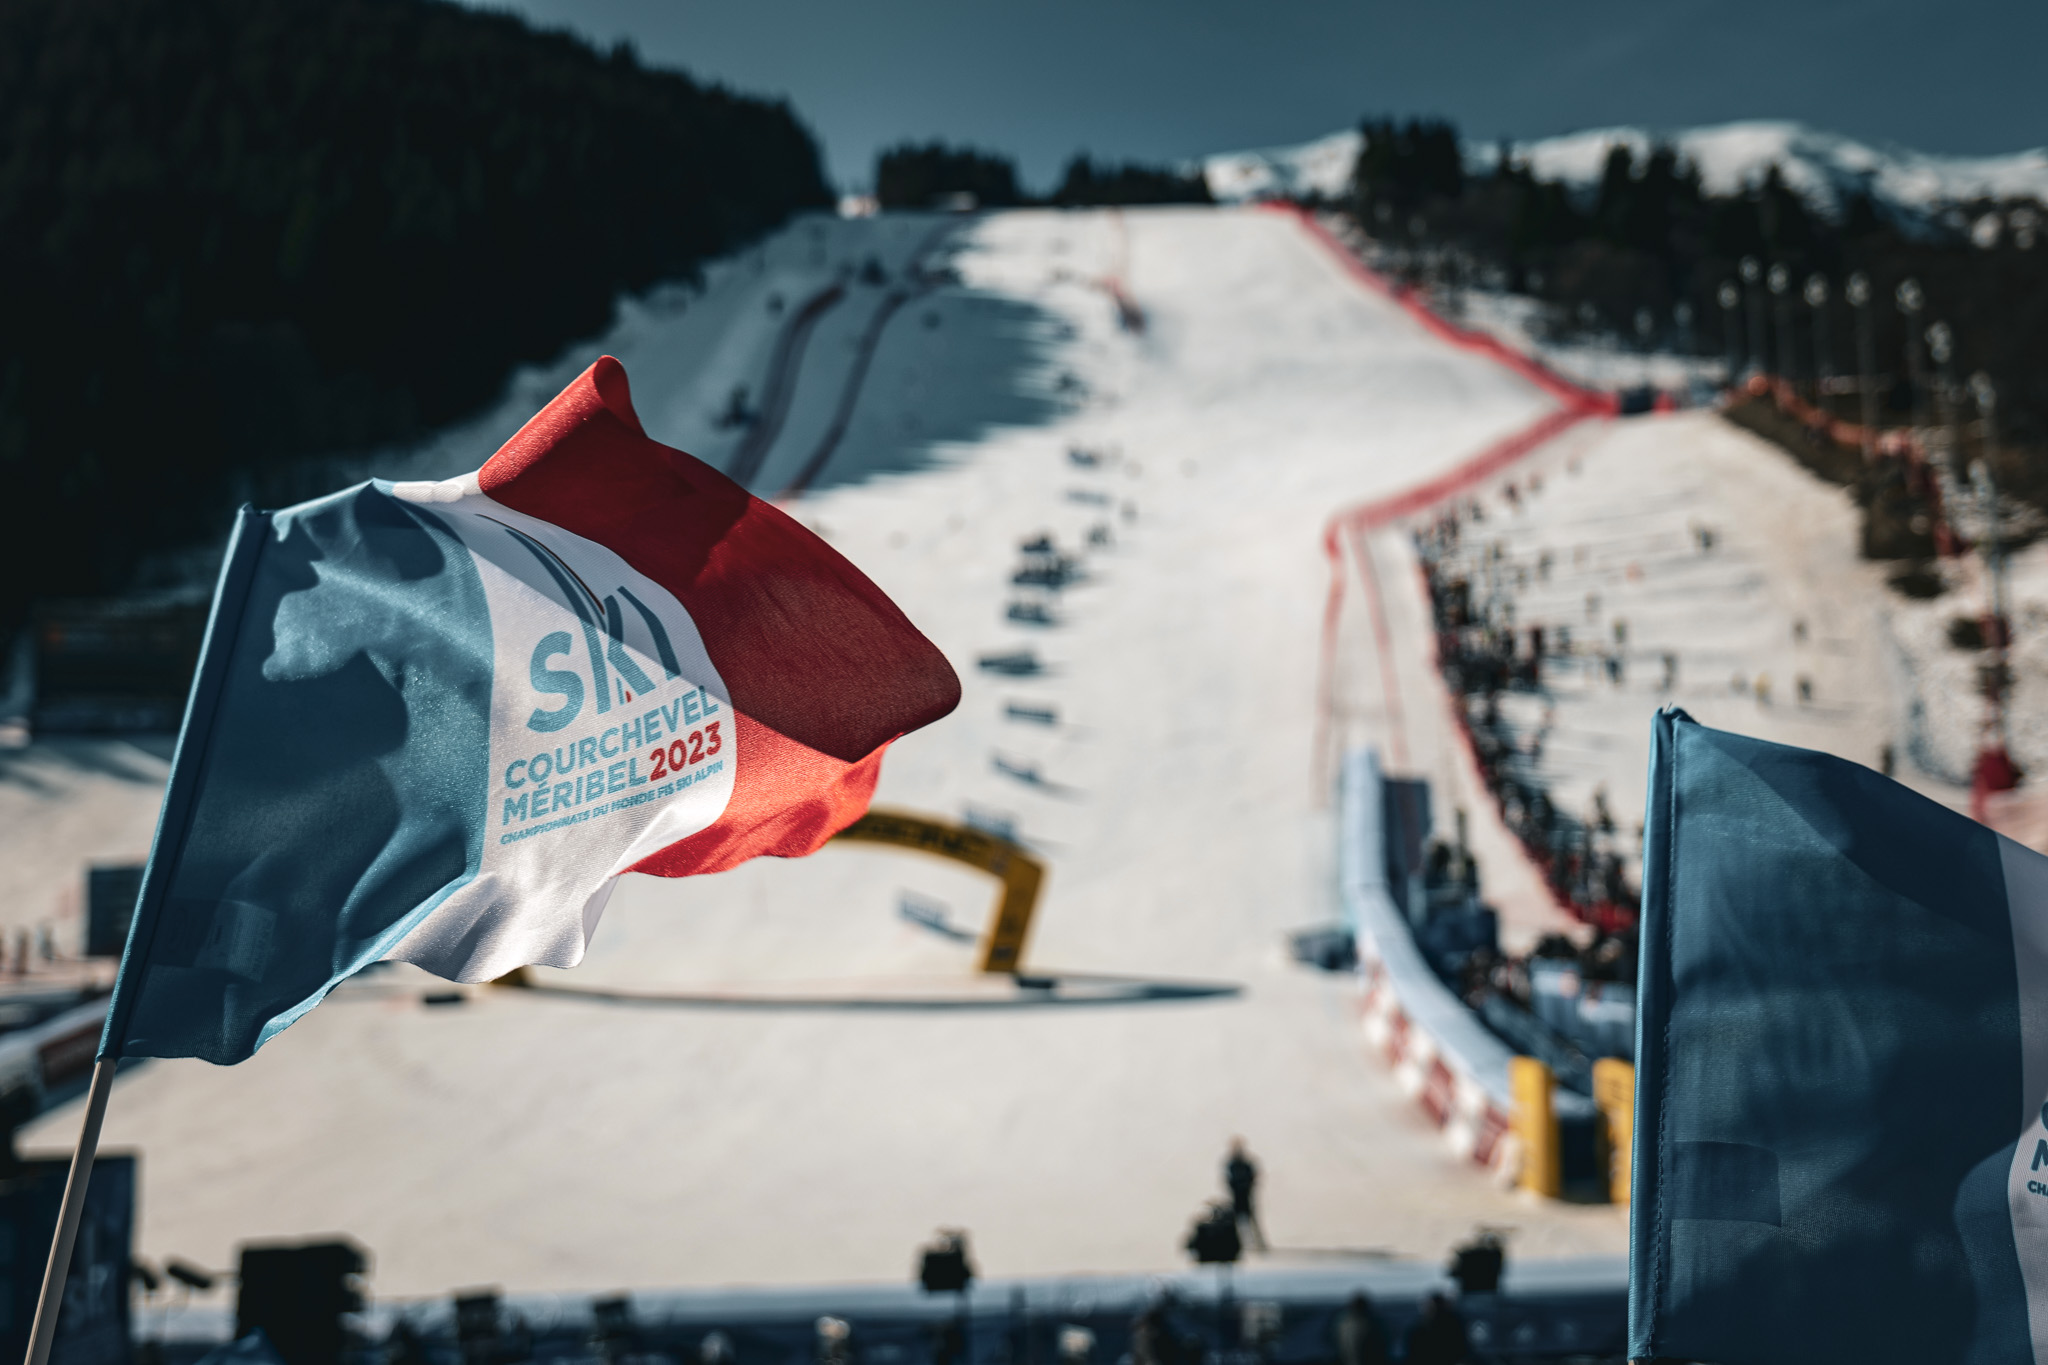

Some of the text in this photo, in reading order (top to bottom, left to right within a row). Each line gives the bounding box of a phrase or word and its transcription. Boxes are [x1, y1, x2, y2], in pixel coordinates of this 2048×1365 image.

[526, 580, 681, 734] SKI
[502, 720, 722, 826] MÉRIBEL 2023
[505, 684, 719, 789] COURCHEVEL
[500, 760, 724, 845] CHAMPIONNATS DU MONDE FIS SKI ALPIN
